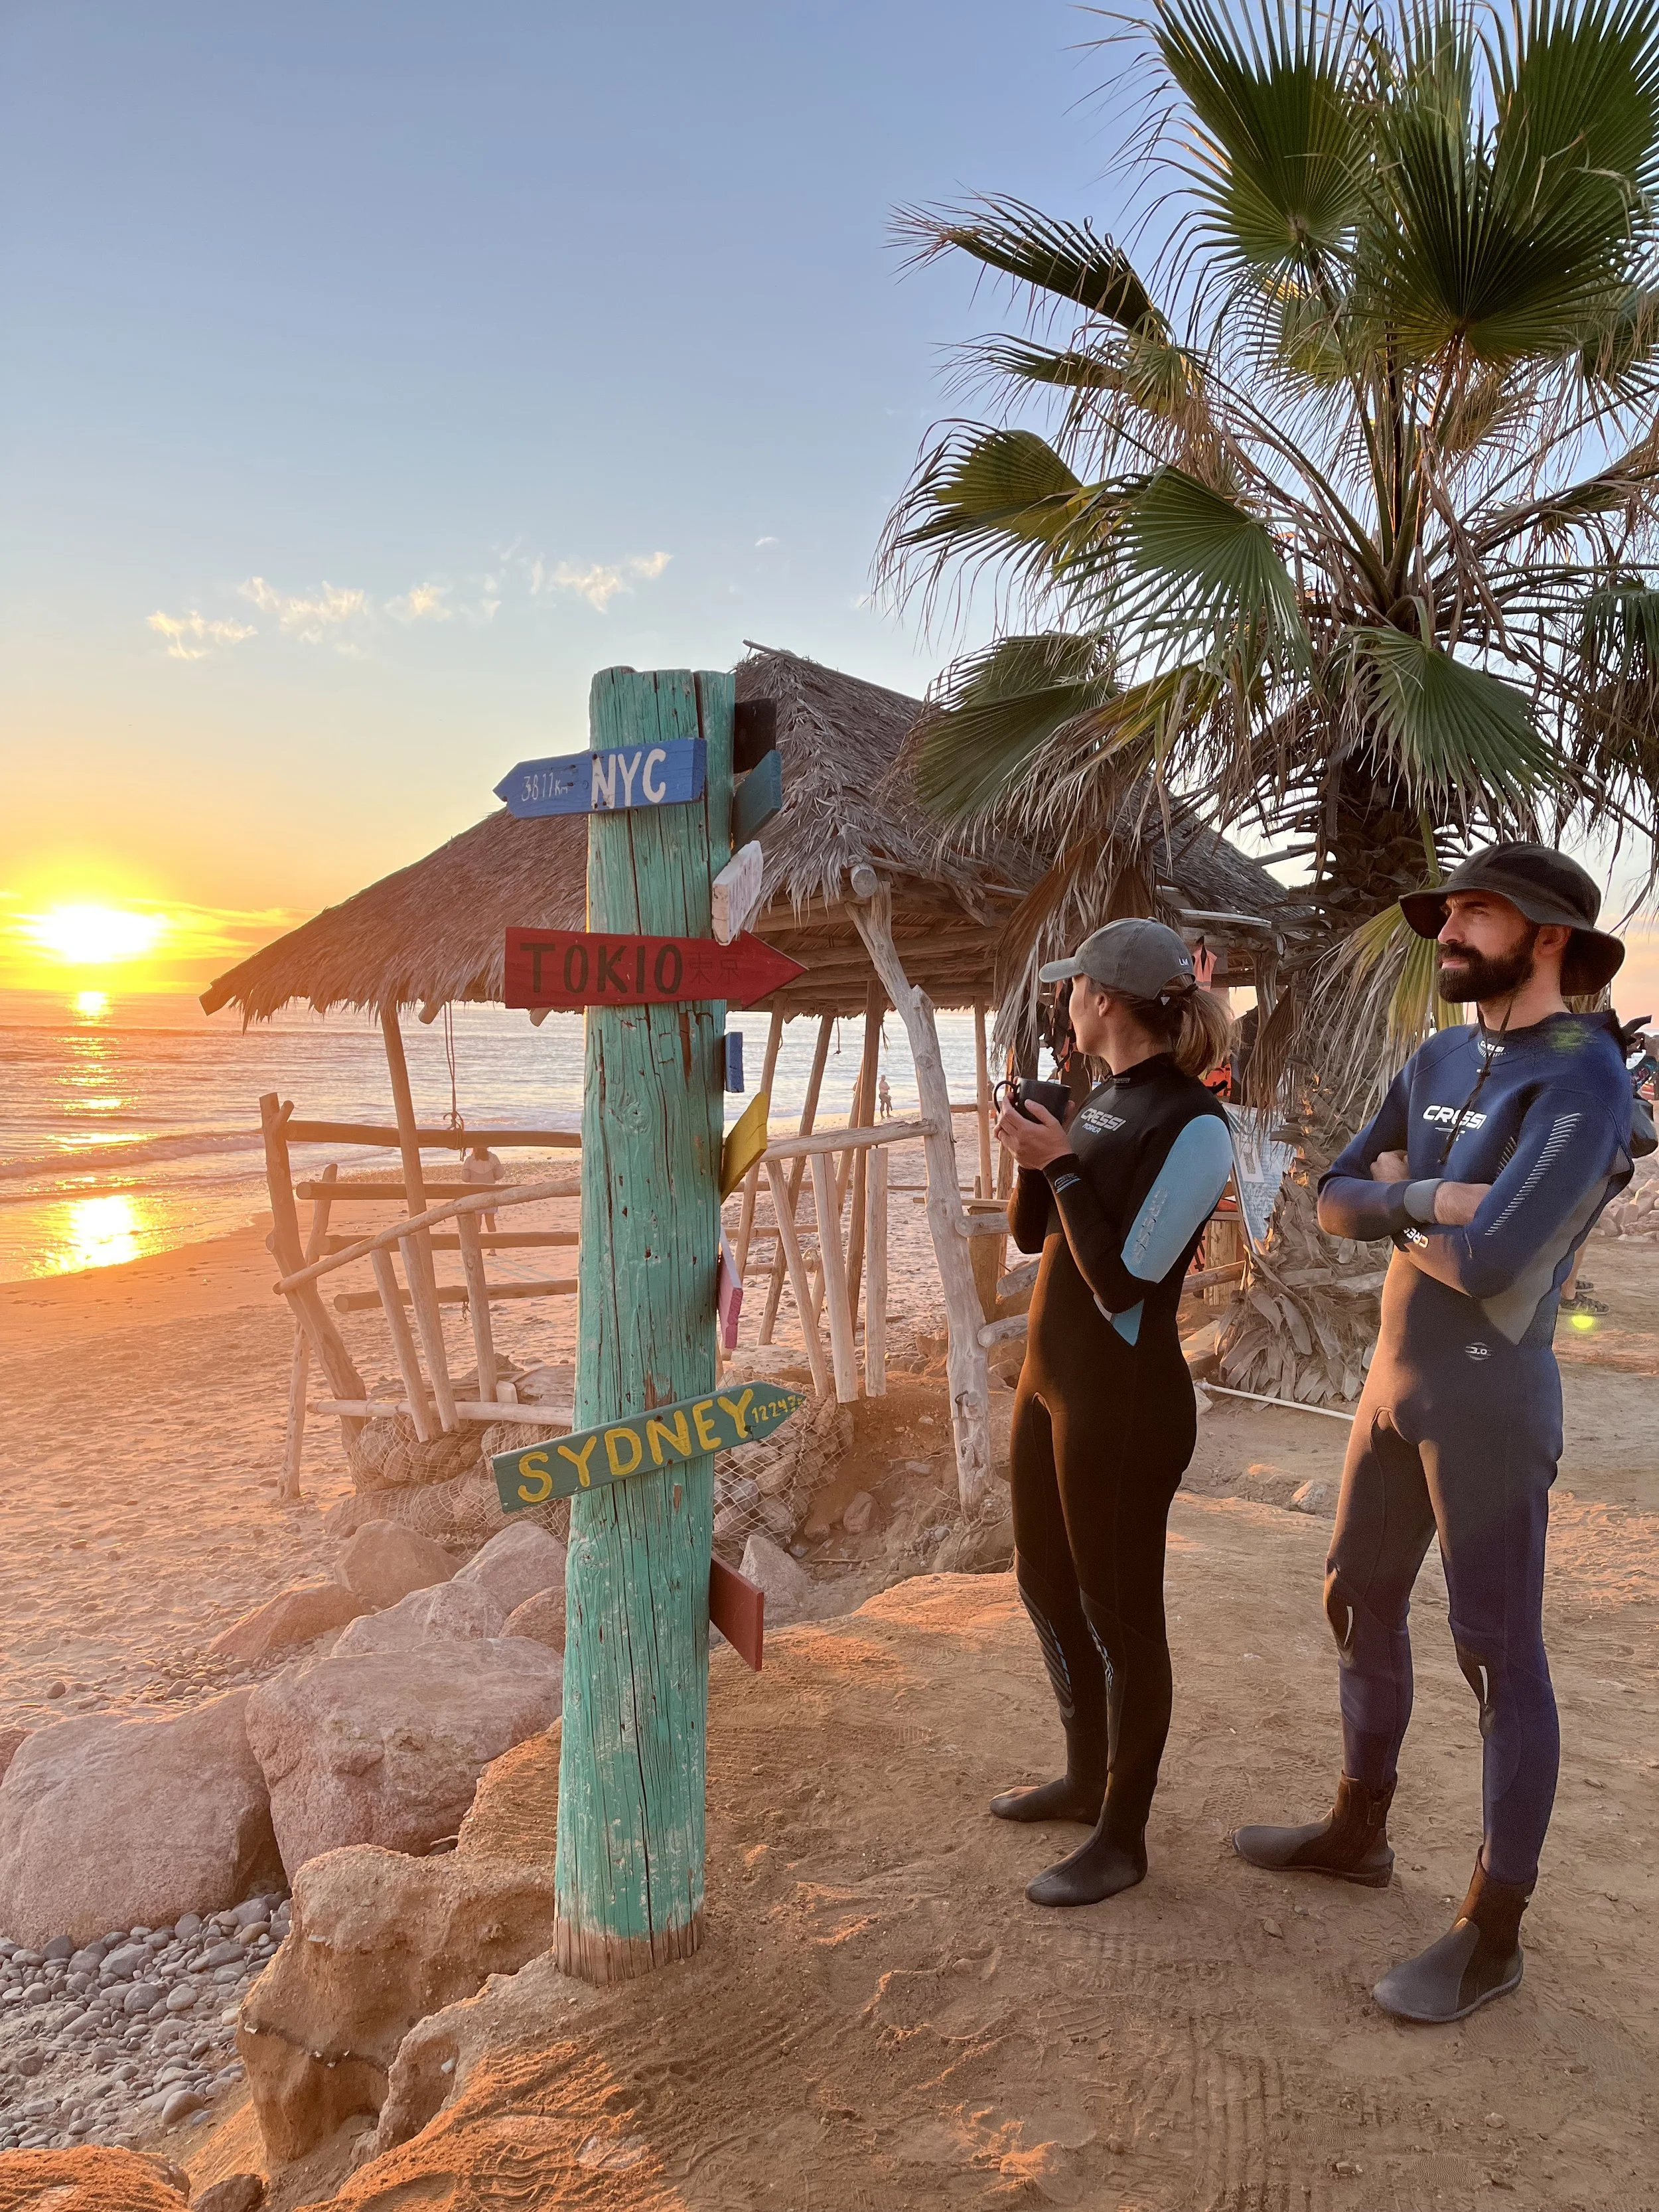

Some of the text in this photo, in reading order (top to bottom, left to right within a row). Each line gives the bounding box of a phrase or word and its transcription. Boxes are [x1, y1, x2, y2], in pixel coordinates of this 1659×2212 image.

[591, 748, 666, 809] NYC
[520, 943, 683, 994] TOKIO
[1080, 1108, 1127, 1132] CRESSI
[518, 1388, 754, 1503] SYDNEY
